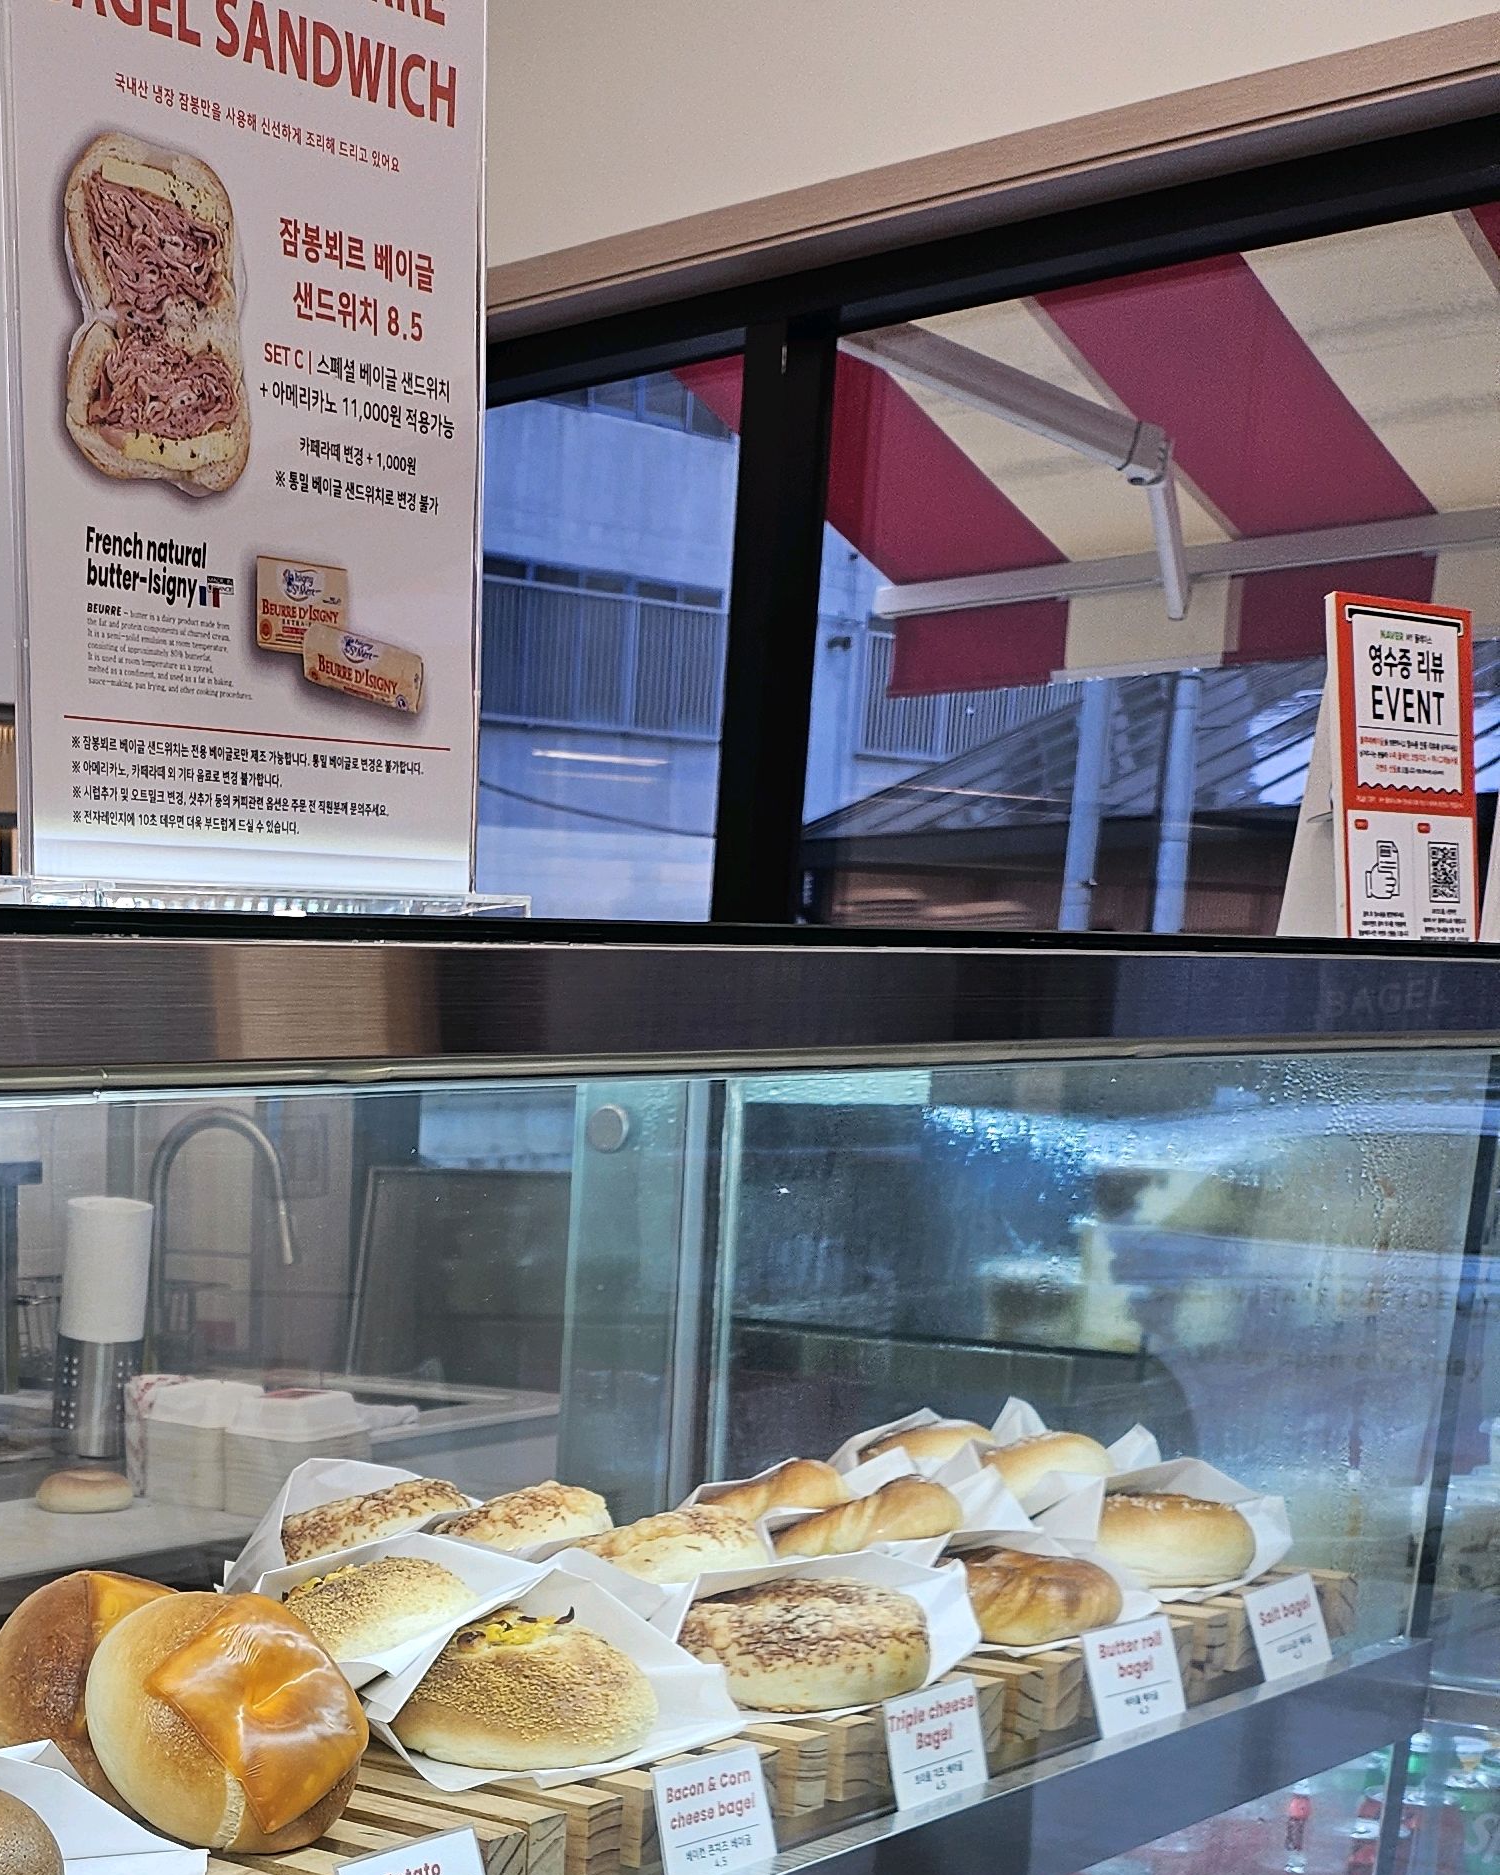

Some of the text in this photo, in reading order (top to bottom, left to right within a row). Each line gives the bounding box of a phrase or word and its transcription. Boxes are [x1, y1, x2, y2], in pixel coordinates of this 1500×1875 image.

[216, 0, 456, 128] SANDWICH
[280, 217, 434, 293] 잠봉뵈르 베이글
[293, 281, 423, 342] 샌드위치 8.5
[264, 342, 450, 403] SET C 스페셜 베이글 샌드위치
[86, 526, 207, 569] French natural
[86, 558, 198, 608] butter-Isigny
[87, 603, 122, 617] BEURRE
[262, 598, 296, 619] BEURRE
[1369, 644, 1444, 683] 영수증 리뷰
[1372, 685, 1444, 725] EVENT
[888, 1695, 975, 1733] Triple cheese
[666, 1770, 751, 1803] Bacon & Corn
[670, 1792, 756, 1830] cheese bagel
